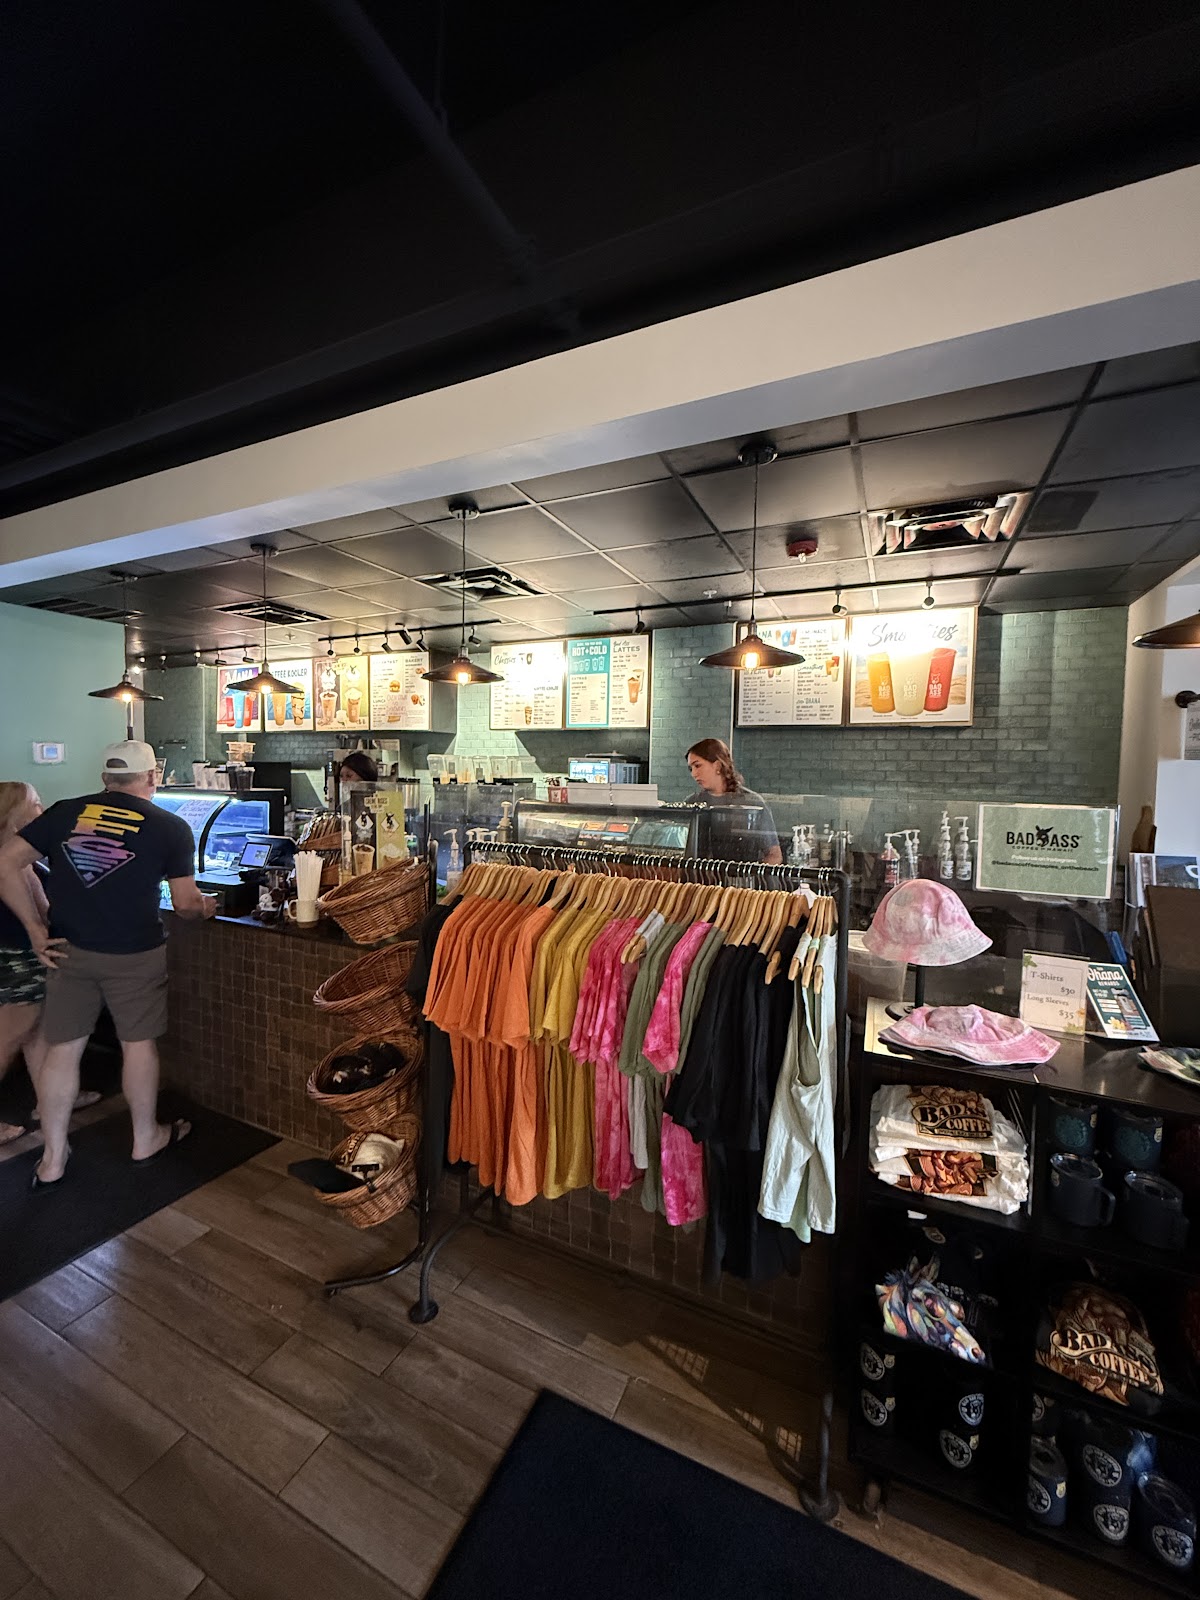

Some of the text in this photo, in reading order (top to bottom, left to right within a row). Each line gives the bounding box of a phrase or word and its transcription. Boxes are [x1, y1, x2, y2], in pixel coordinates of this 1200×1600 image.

[868, 622, 958, 647] Smoies
[287, 668, 307, 678] KOOLER
[1006, 831, 1080, 848] BAD ASS
[1030, 970, 1064, 982] T-Shirts
[1061, 985, 1075, 995] $30
[1027, 993, 1069, 1006] Long Sleeves
[1059, 1009, 1075, 1019] $35
[920, 1104, 962, 1122] BAD
[1059, 1329, 1107, 1351] BAD
